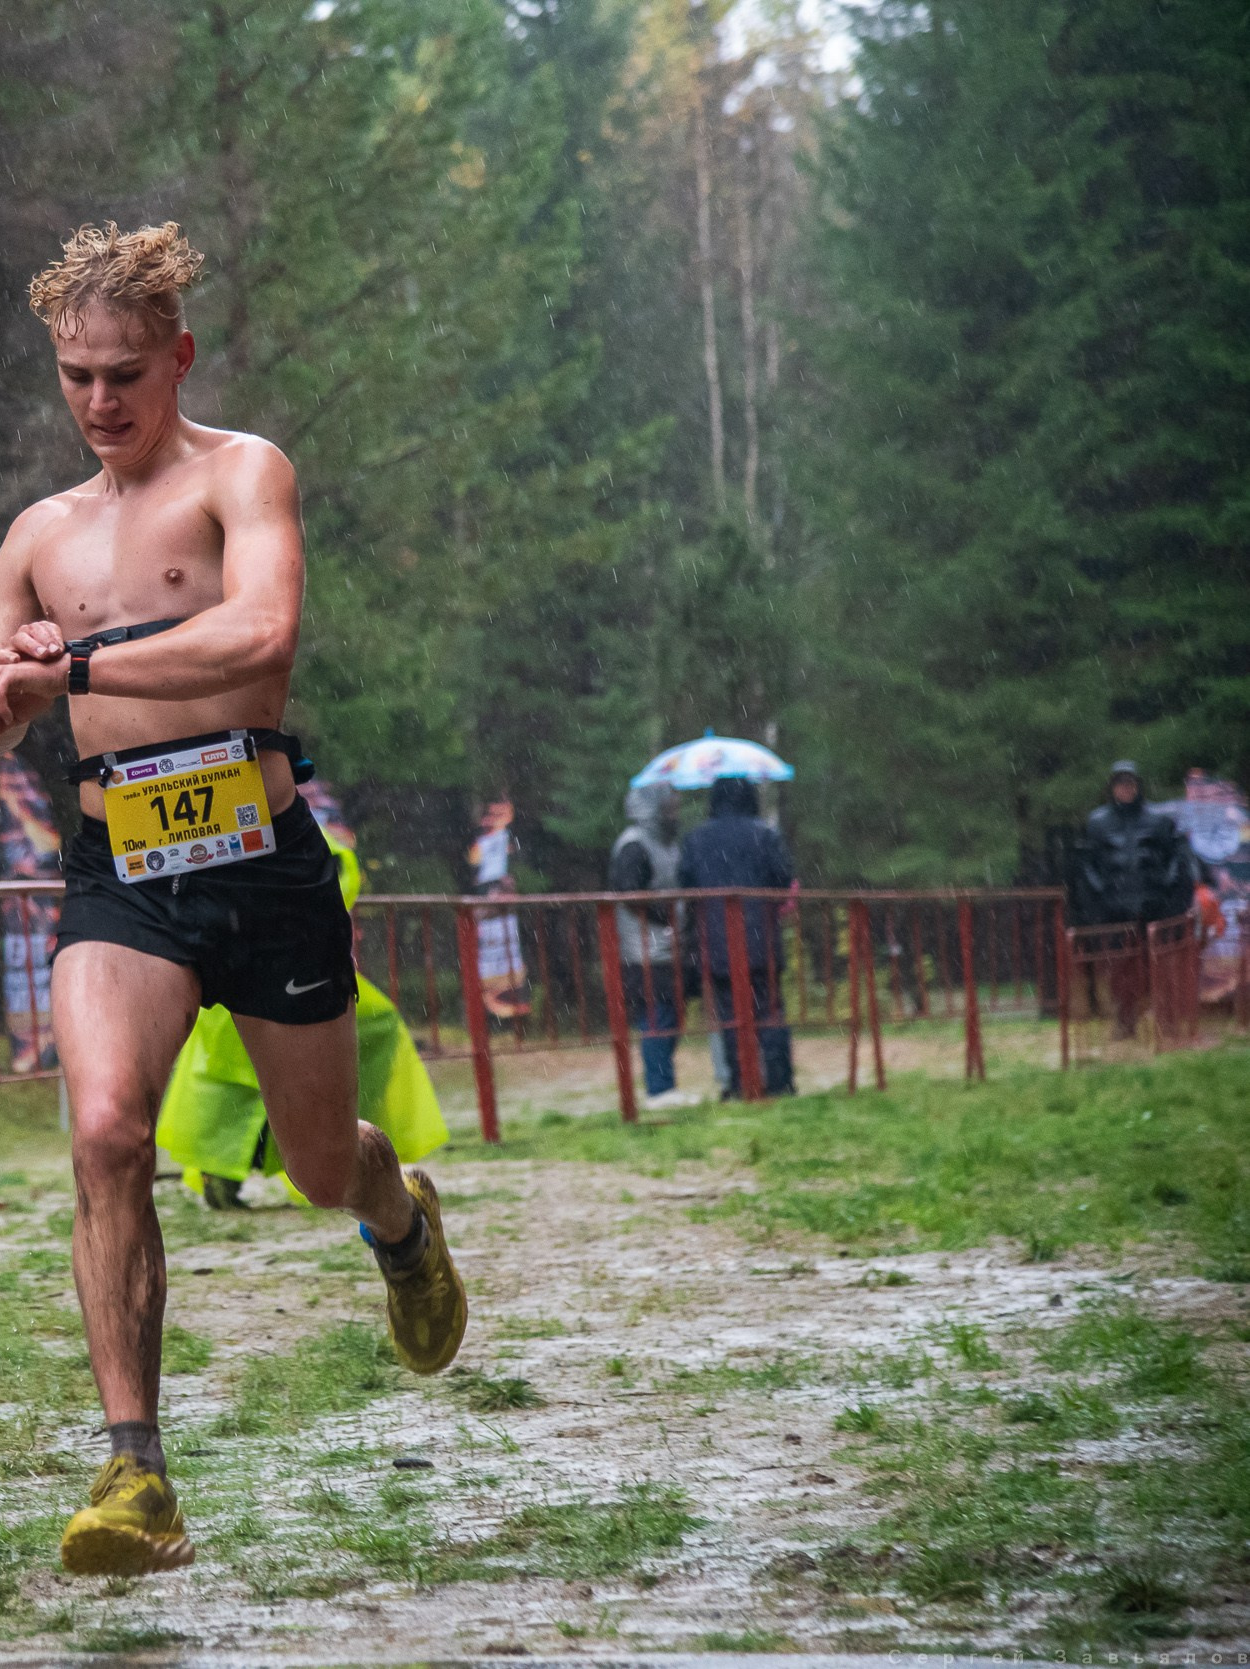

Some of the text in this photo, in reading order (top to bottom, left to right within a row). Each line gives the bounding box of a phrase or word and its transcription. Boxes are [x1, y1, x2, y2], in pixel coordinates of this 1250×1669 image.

[142, 774, 200, 796] УРАЛЬСКИЙ
[201, 767, 241, 784] ВУЛКАН
[150, 785, 214, 831] 147
[168, 823, 222, 843] ЛИПОВАЯ
